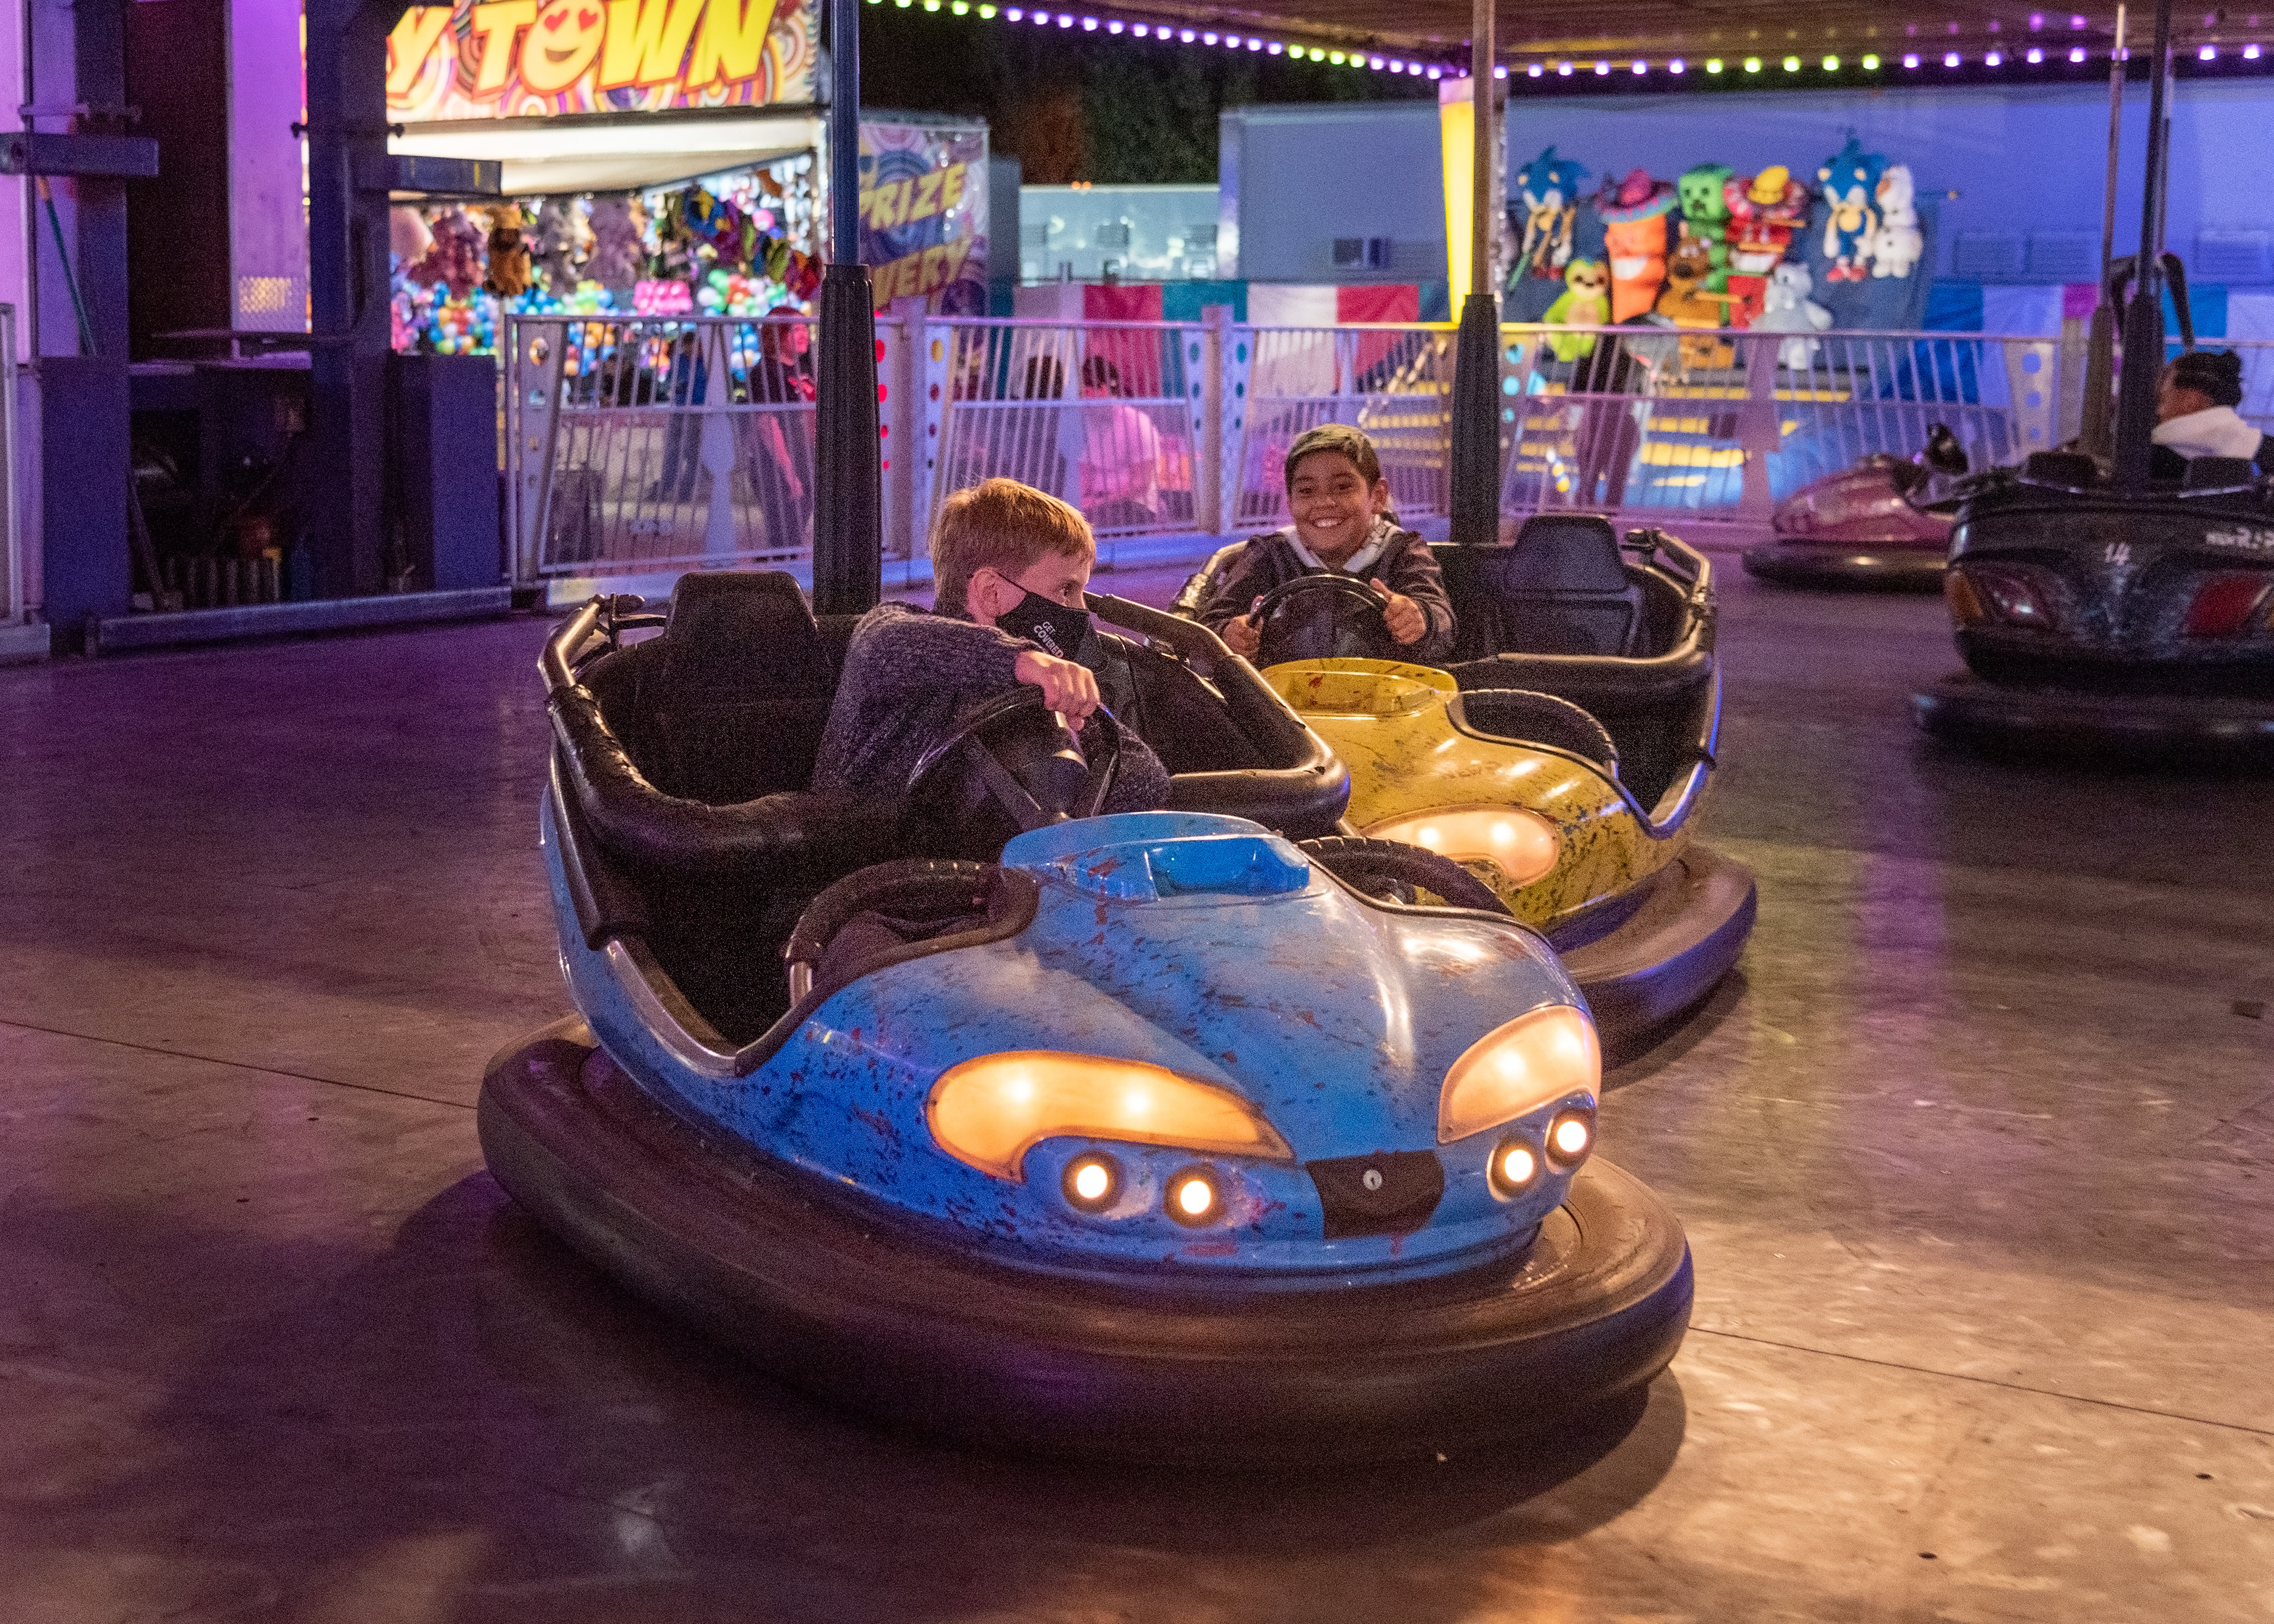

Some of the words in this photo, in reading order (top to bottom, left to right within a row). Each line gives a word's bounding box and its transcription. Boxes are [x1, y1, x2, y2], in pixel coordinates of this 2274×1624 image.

[472, 0, 776, 98] TOWN
[872, 236, 972, 310] VERY
[1034, 625, 1064, 658] COVERED
[1042, 621, 1056, 635] GET
